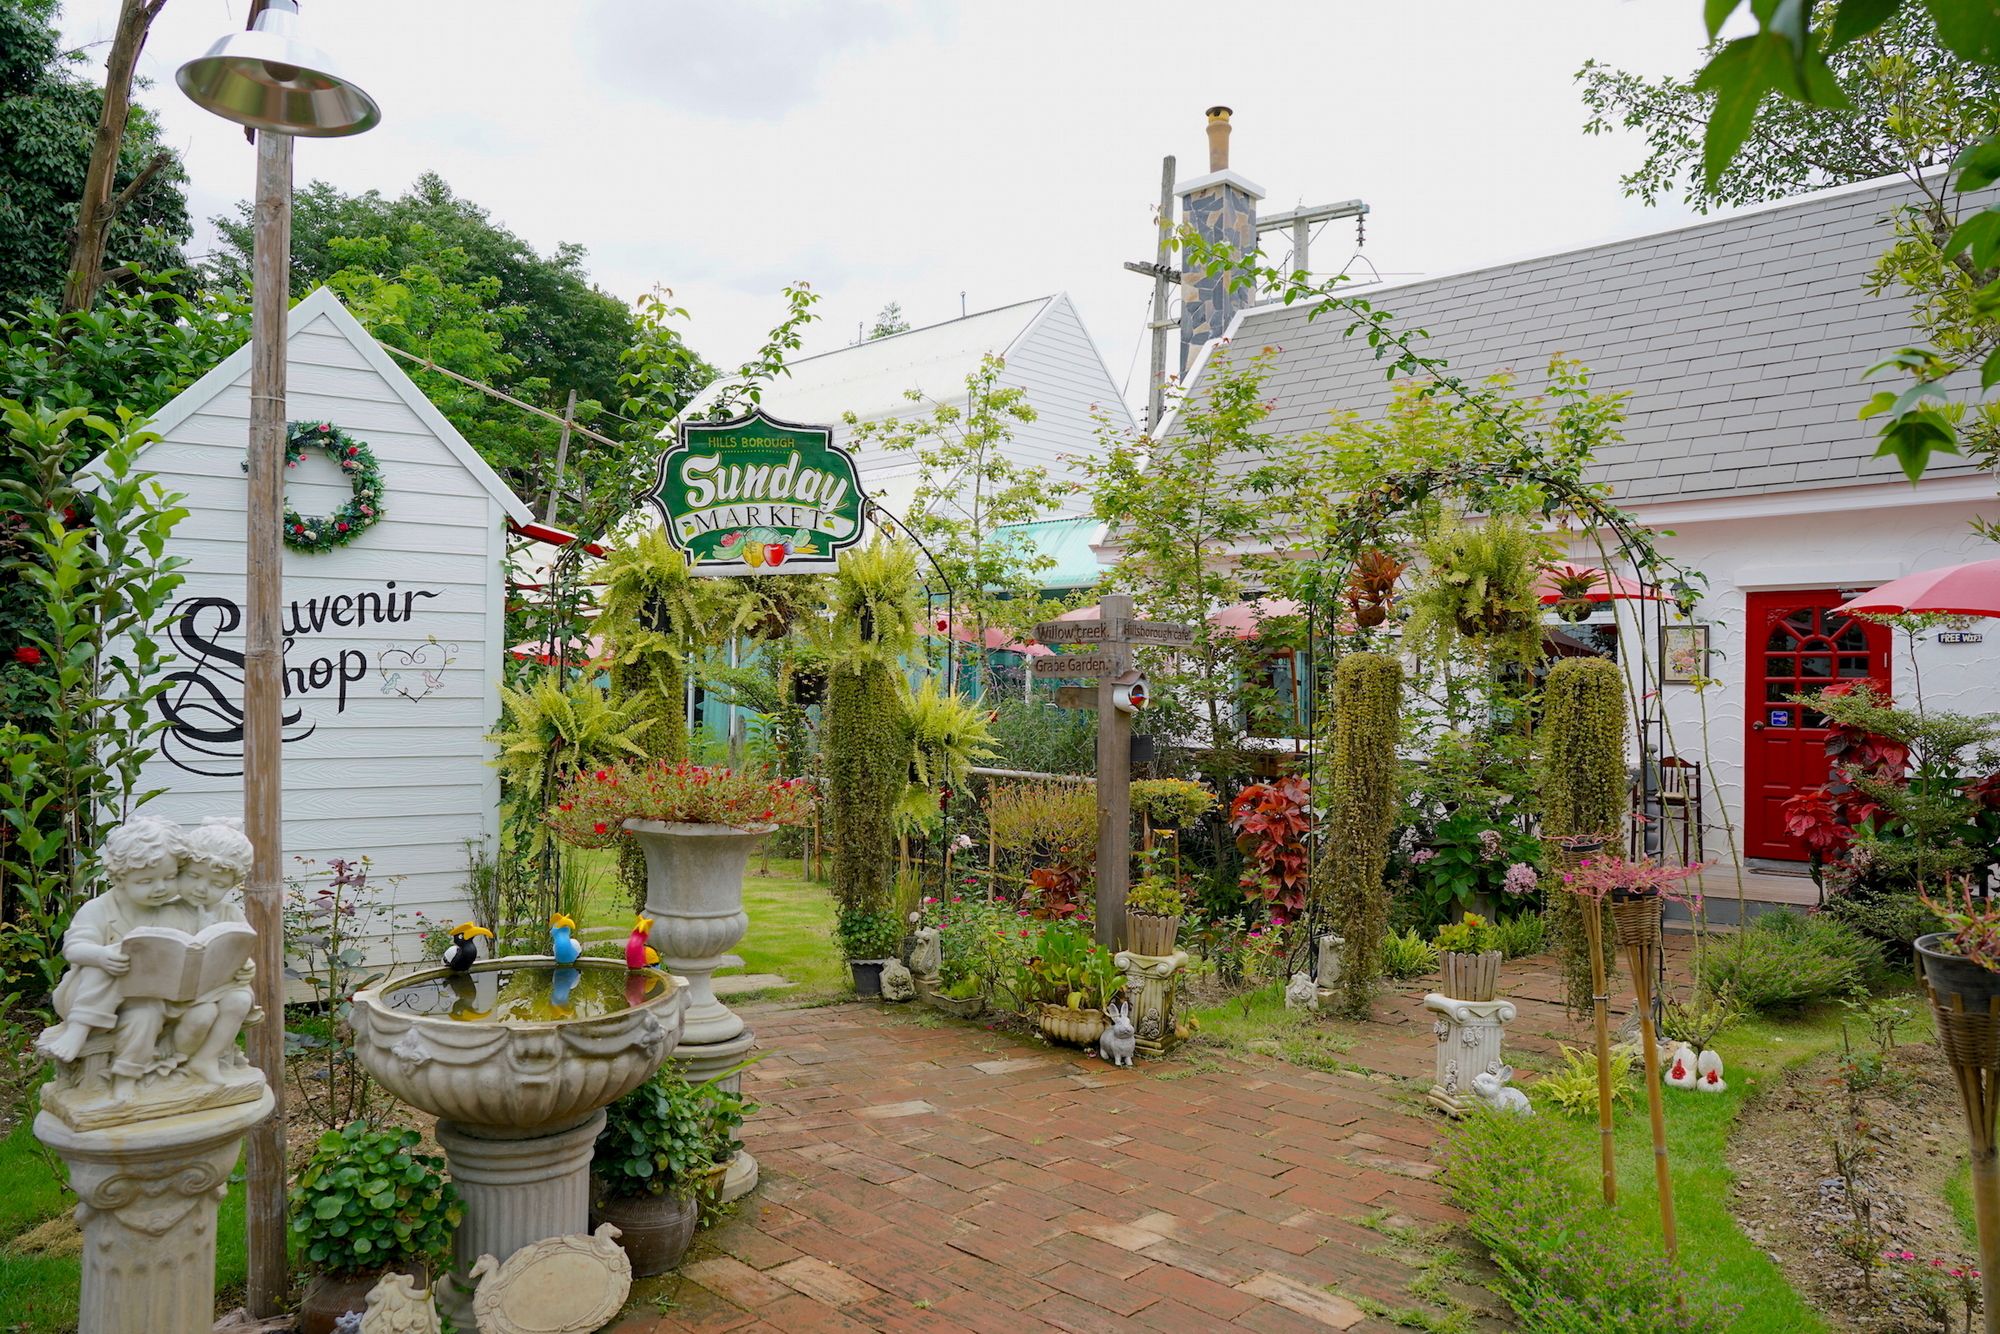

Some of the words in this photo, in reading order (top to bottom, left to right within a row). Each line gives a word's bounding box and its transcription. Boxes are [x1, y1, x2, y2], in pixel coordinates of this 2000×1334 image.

[708, 437, 737, 448] HILLS
[741, 437, 795, 448] BOROUGH
[681, 450, 848, 513] Sunday
[694, 505, 823, 534] MARKET
[1037, 624, 1074, 640] Willow
[1123, 624, 1172, 641] Hillsborough
[1940, 633, 1960, 643] FREE
[1068, 657, 1109, 672] Garden.
